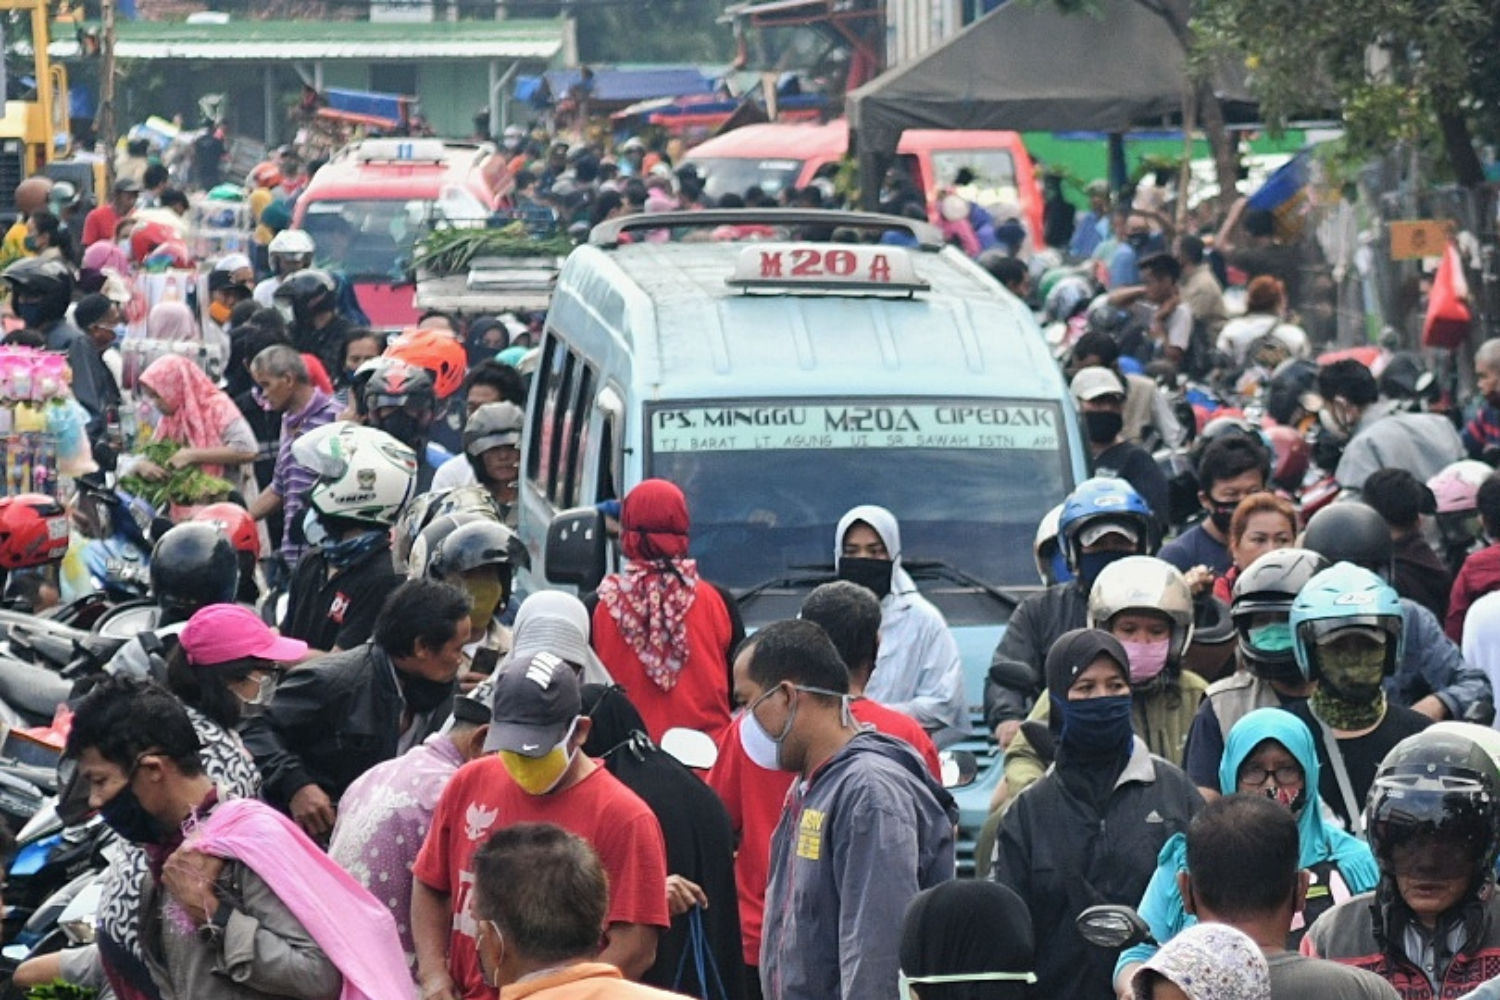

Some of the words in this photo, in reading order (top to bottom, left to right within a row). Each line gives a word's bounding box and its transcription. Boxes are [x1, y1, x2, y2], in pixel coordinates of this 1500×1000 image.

[703, 408, 806, 428] MINGGU
[935, 406, 1052, 427] CIPEDAK
[690, 436, 737, 449] BARAT
[784, 434, 833, 448] AGUNG
[916, 434, 969, 448] SAWAH
